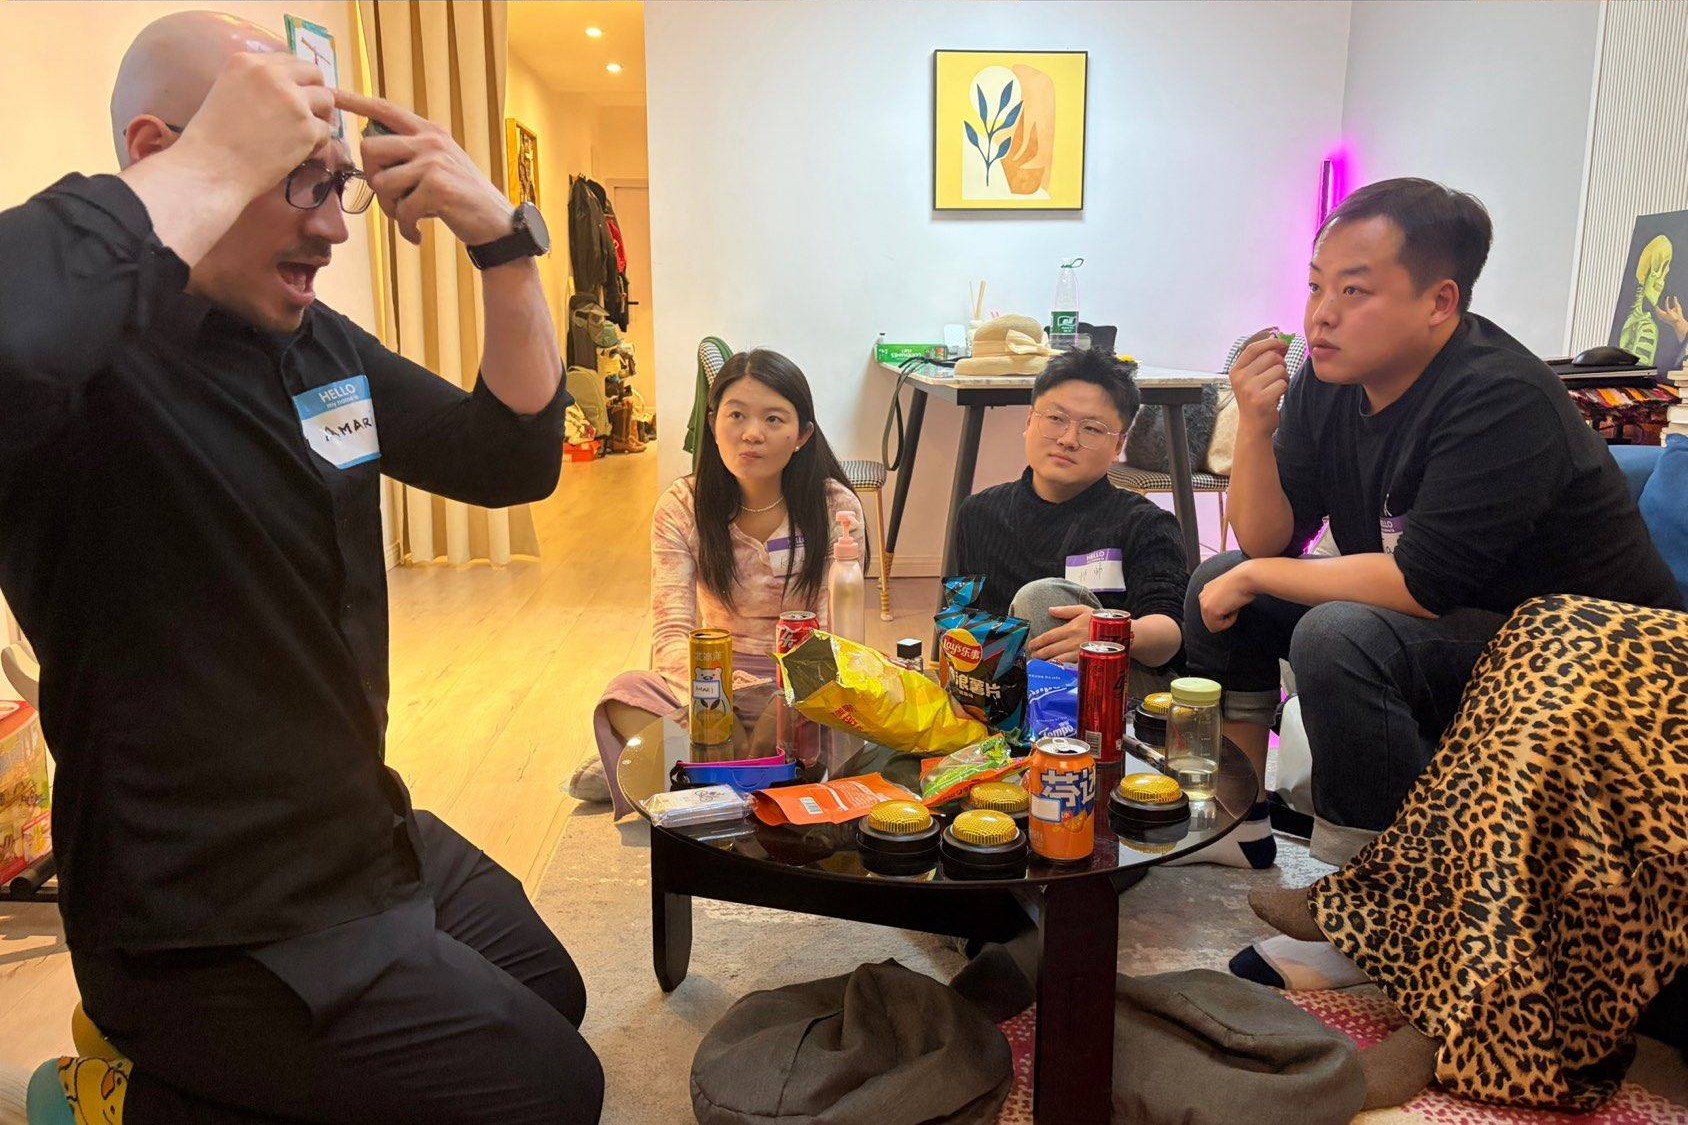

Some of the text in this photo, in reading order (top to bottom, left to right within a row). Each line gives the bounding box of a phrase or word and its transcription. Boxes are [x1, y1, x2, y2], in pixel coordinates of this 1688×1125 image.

[319, 384, 356, 403] HELLO
[324, 417, 372, 442] AMAR
[1086, 550, 1105, 561] HELLO
[943, 638, 962, 655] Lay's
